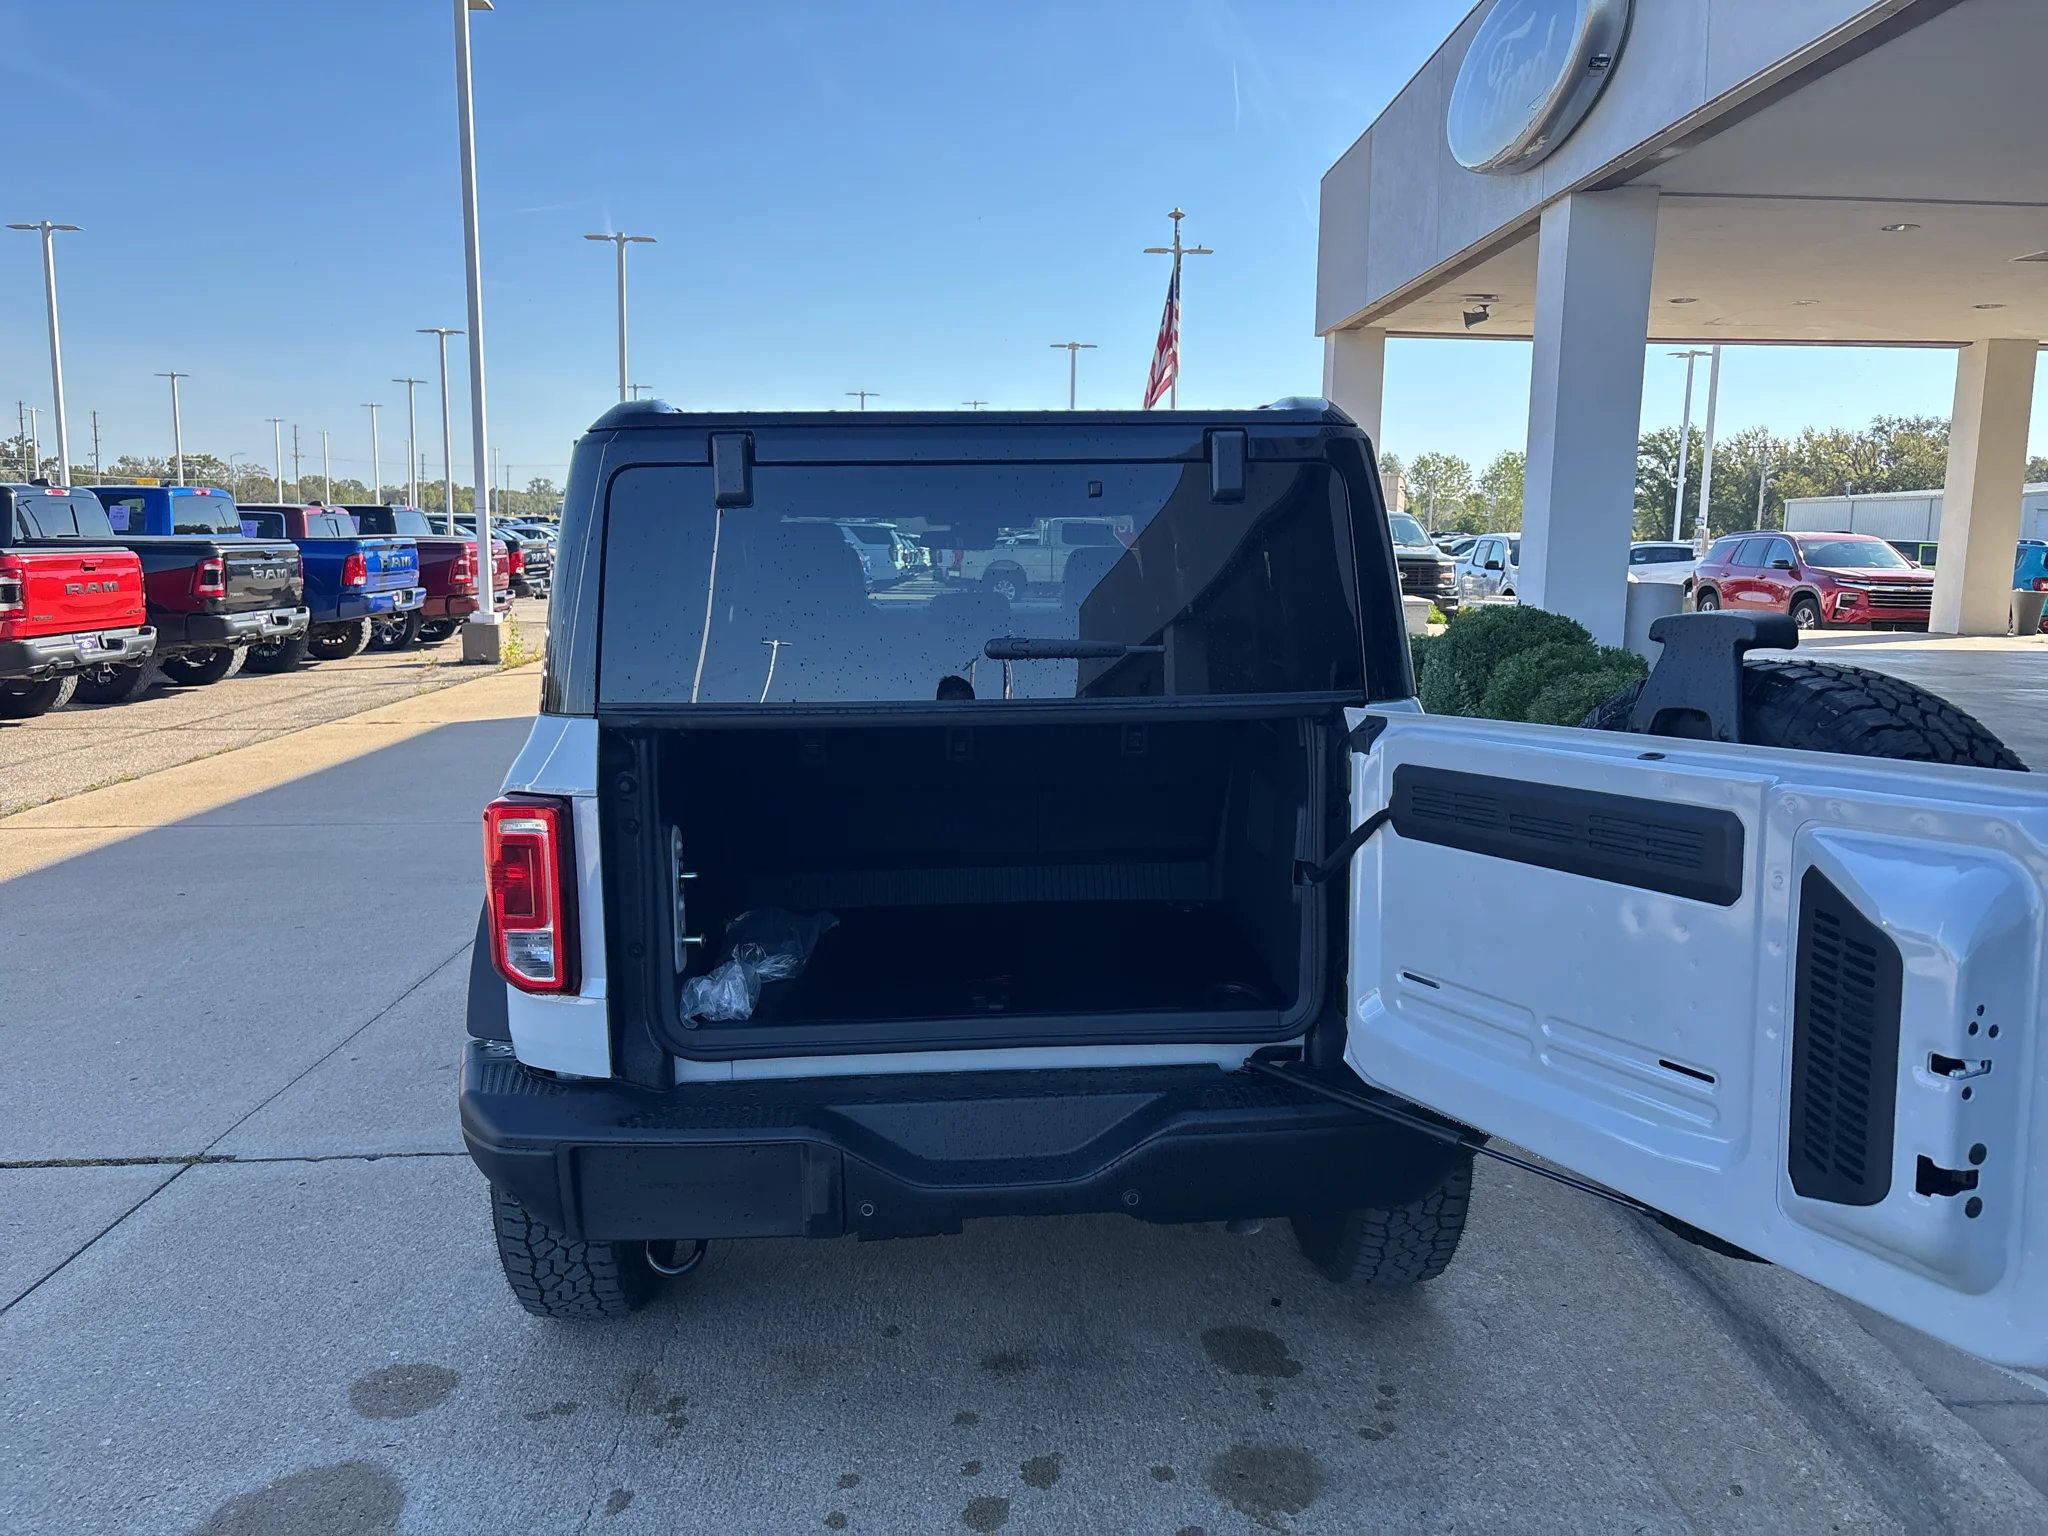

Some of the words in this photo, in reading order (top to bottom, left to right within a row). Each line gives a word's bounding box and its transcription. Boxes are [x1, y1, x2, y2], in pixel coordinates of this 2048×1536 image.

[1481, 11, 1559, 124] Ford
[379, 556, 411, 569] RAM
[251, 568, 288, 580] RAM
[65, 581, 119, 596] RAM
